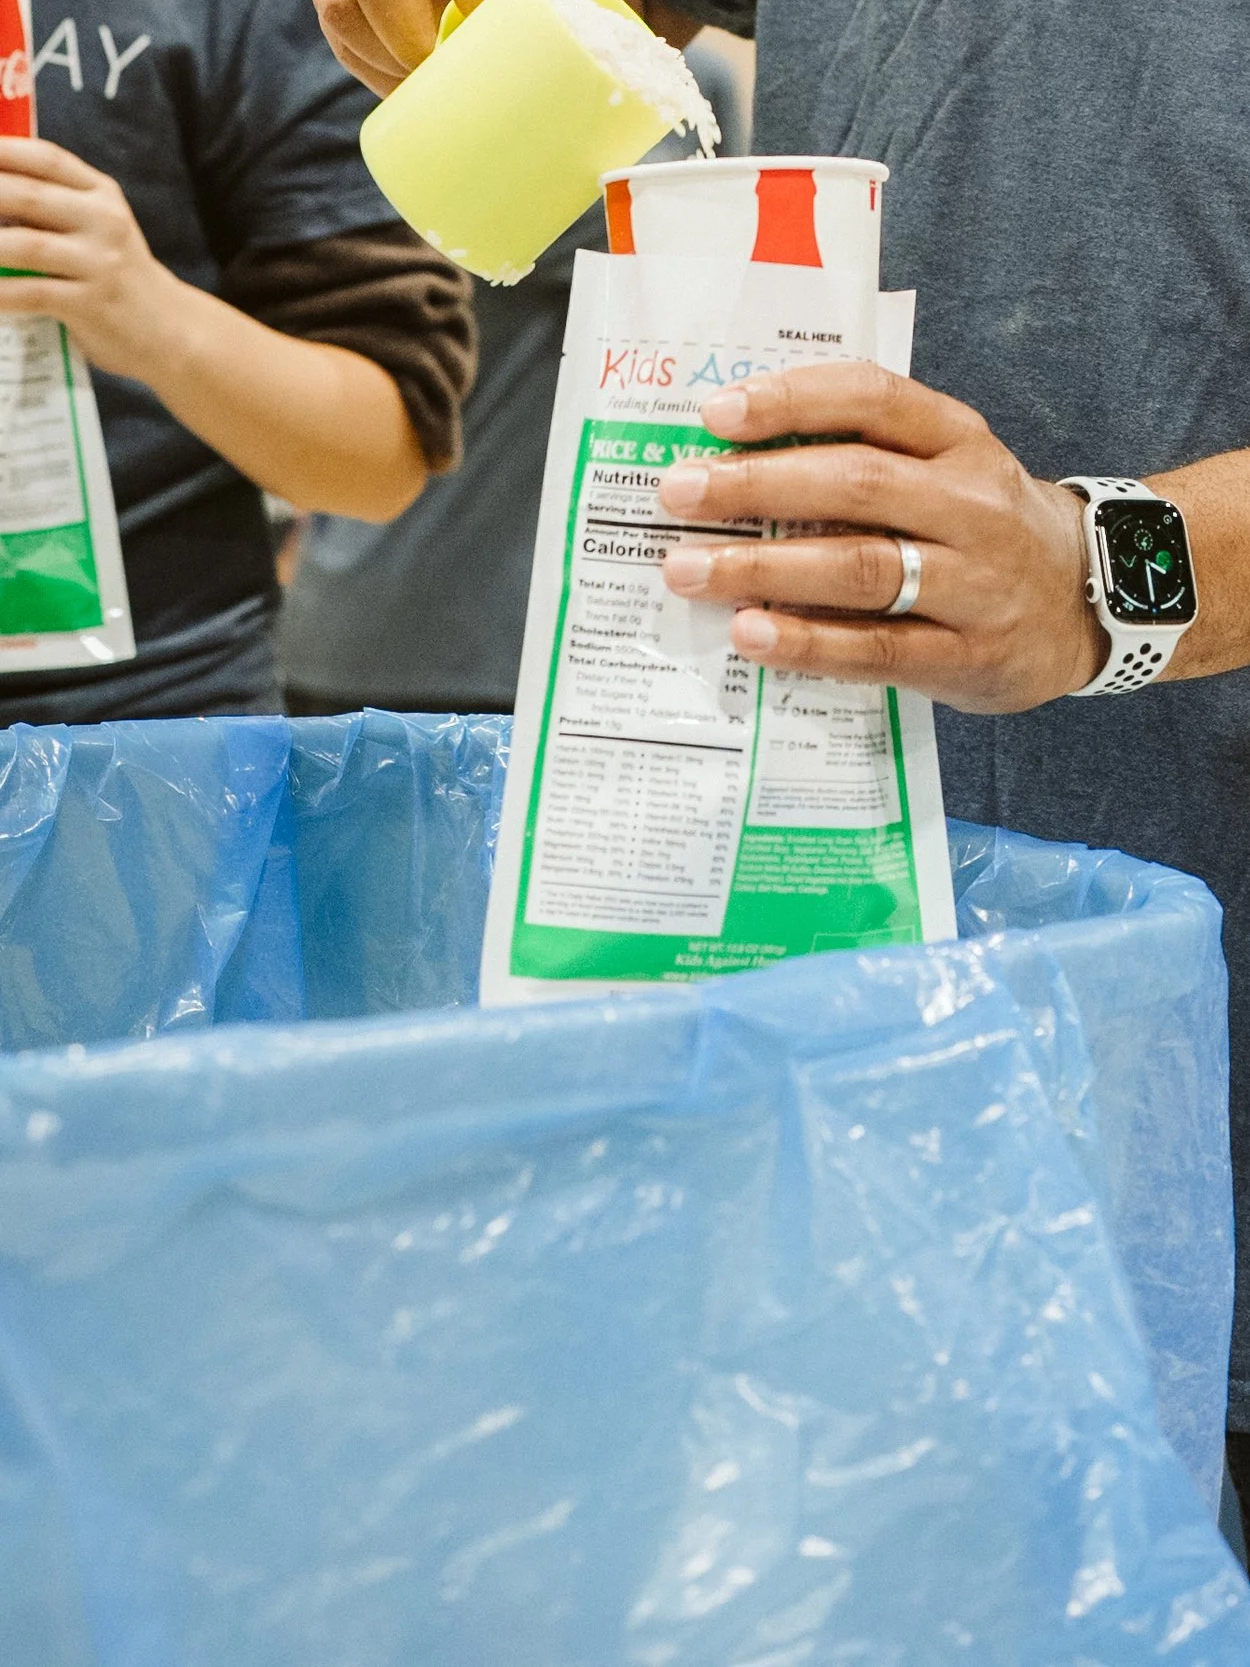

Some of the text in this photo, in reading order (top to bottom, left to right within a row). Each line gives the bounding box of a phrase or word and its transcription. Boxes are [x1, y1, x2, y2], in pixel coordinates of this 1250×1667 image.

[778, 329, 843, 344] SEAL HERE
[599, 348, 677, 390] Kids
[591, 438, 637, 460] RICE
[642, 441, 665, 463] &
[592, 469, 660, 488] Nutritio
[587, 503, 626, 516] Serving
[585, 527, 681, 543] Amount Per Serving
[583, 538, 668, 560] Calories
[578, 579, 605, 589] Total
[609, 581, 626, 592] Fat
[571, 624, 637, 639] Cholesterol
[570, 640, 612, 652] Sodium
[568, 655, 596, 666] Total
[599, 658, 678, 673] Carbohydrate
[559, 716, 601, 727] Protein
